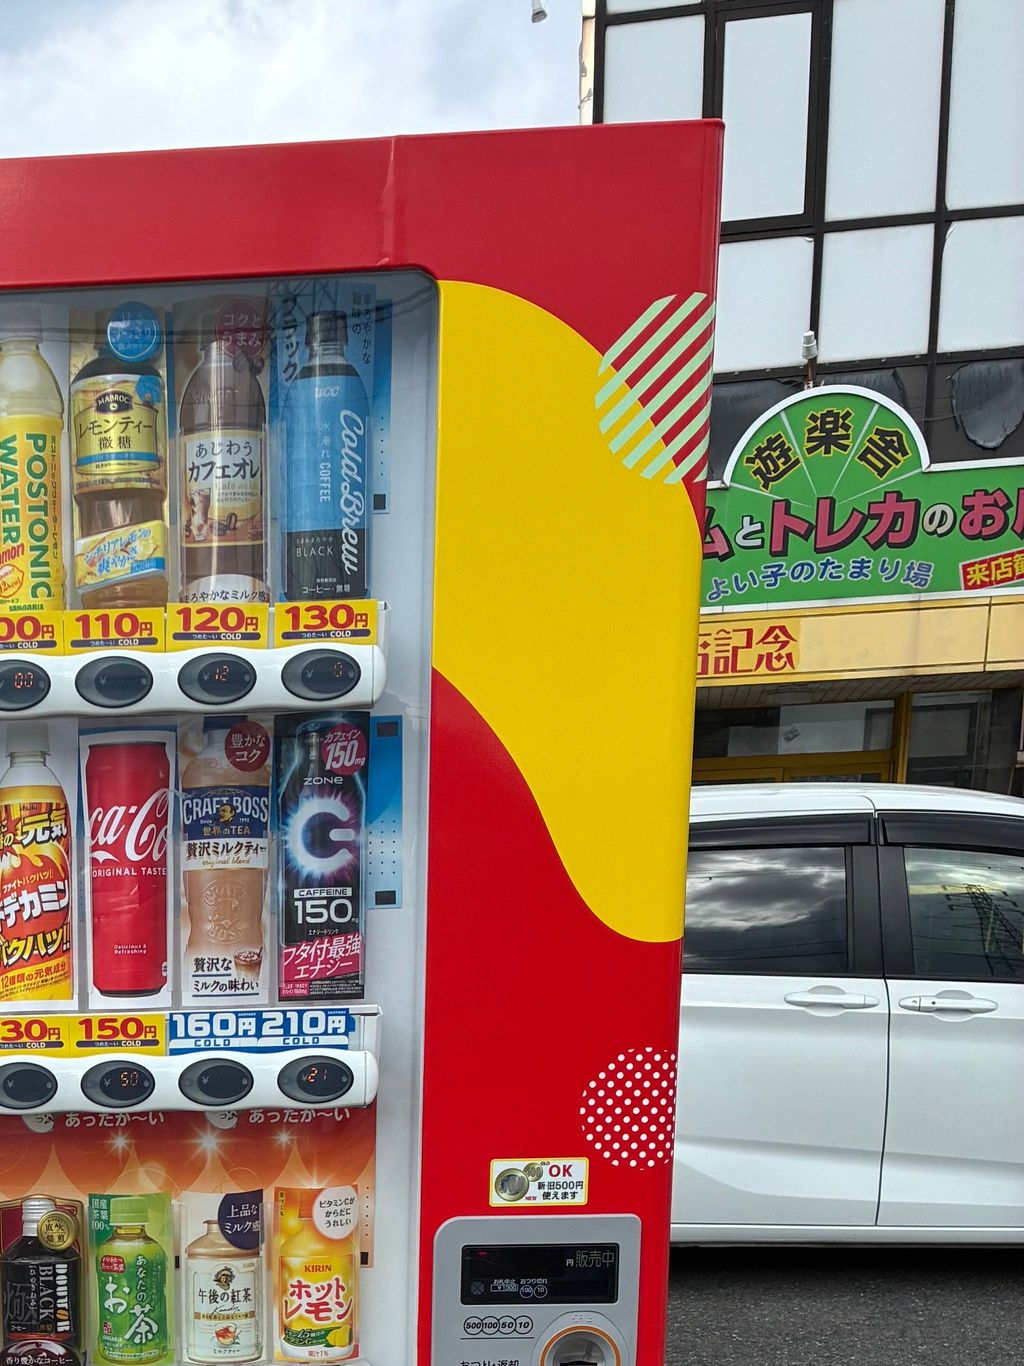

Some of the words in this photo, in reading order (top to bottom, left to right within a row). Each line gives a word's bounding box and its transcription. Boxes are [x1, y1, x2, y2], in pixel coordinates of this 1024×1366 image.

[78, 415, 154, 438] レモンティー
[98, 434, 132, 450] 微糖
[195, 440, 253, 459] あじわう
[743, 408, 912, 491] 遊楽舎
[188, 458, 260, 483] カフェオレ
[25, 432, 53, 600] POSTONIC
[702, 489, 1024, 560] ムとトレカのお
[295, 545, 334, 558] BLACK
[707, 557, 934, 601] よい子のたまり場
[75, 613, 153, 639] 110円
[175, 606, 258, 632] 120円
[284, 605, 368, 630] 130円
[92, 866, 138, 877] ORIGINAL
[298, 888, 349, 896] CAFFEINE
[294, 959, 353, 980] エナジー
[193, 979, 260, 993] ミルクの味わい
[77, 1017, 157, 1040] 150円
[171, 1012, 256, 1037] 160円
[261, 1011, 346, 1036] 210円
[548, 1164, 573, 1178] OK
[542, 1191, 579, 1201] 使えます
[226, 1203, 259, 1218] 上品な
[303, 1264, 332, 1273] KIRIN
[576, 1250, 615, 1268] 販売中
[135, 1255, 147, 1302] あなたの
[288, 1277, 347, 1301] ホット
[38, 1265, 54, 1320] BLACK
[197, 1287, 253, 1305] 午後の紅茶
[283, 1299, 352, 1323] レモン
[465, 1321, 482, 1330] 500
[483, 1321, 499, 1330] 100
[501, 1321, 514, 1330] 50
[518, 1321, 530, 1330] 10
[5, 1354, 74, 1365] 香り豊かなコーヒー
